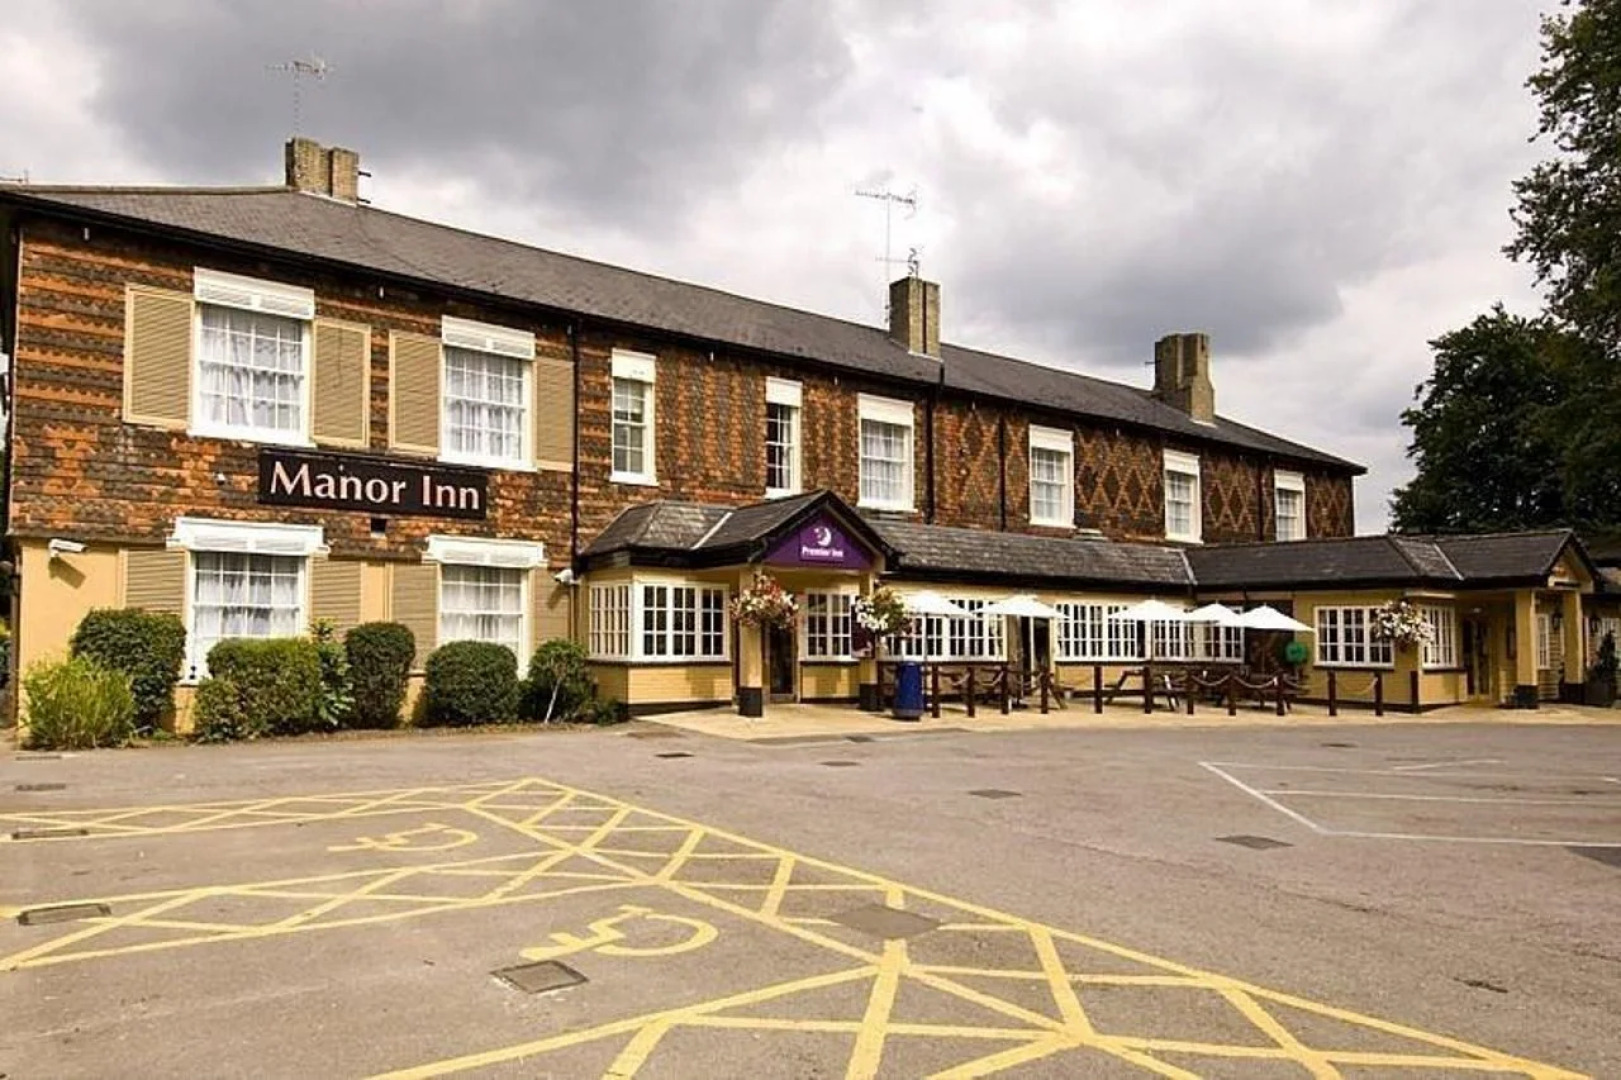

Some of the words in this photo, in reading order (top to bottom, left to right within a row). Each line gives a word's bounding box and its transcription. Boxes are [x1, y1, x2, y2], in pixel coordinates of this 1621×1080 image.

[270, 461, 406, 504] Manor
[422, 475, 480, 510] Inn
[802, 546, 830, 557] Premier
